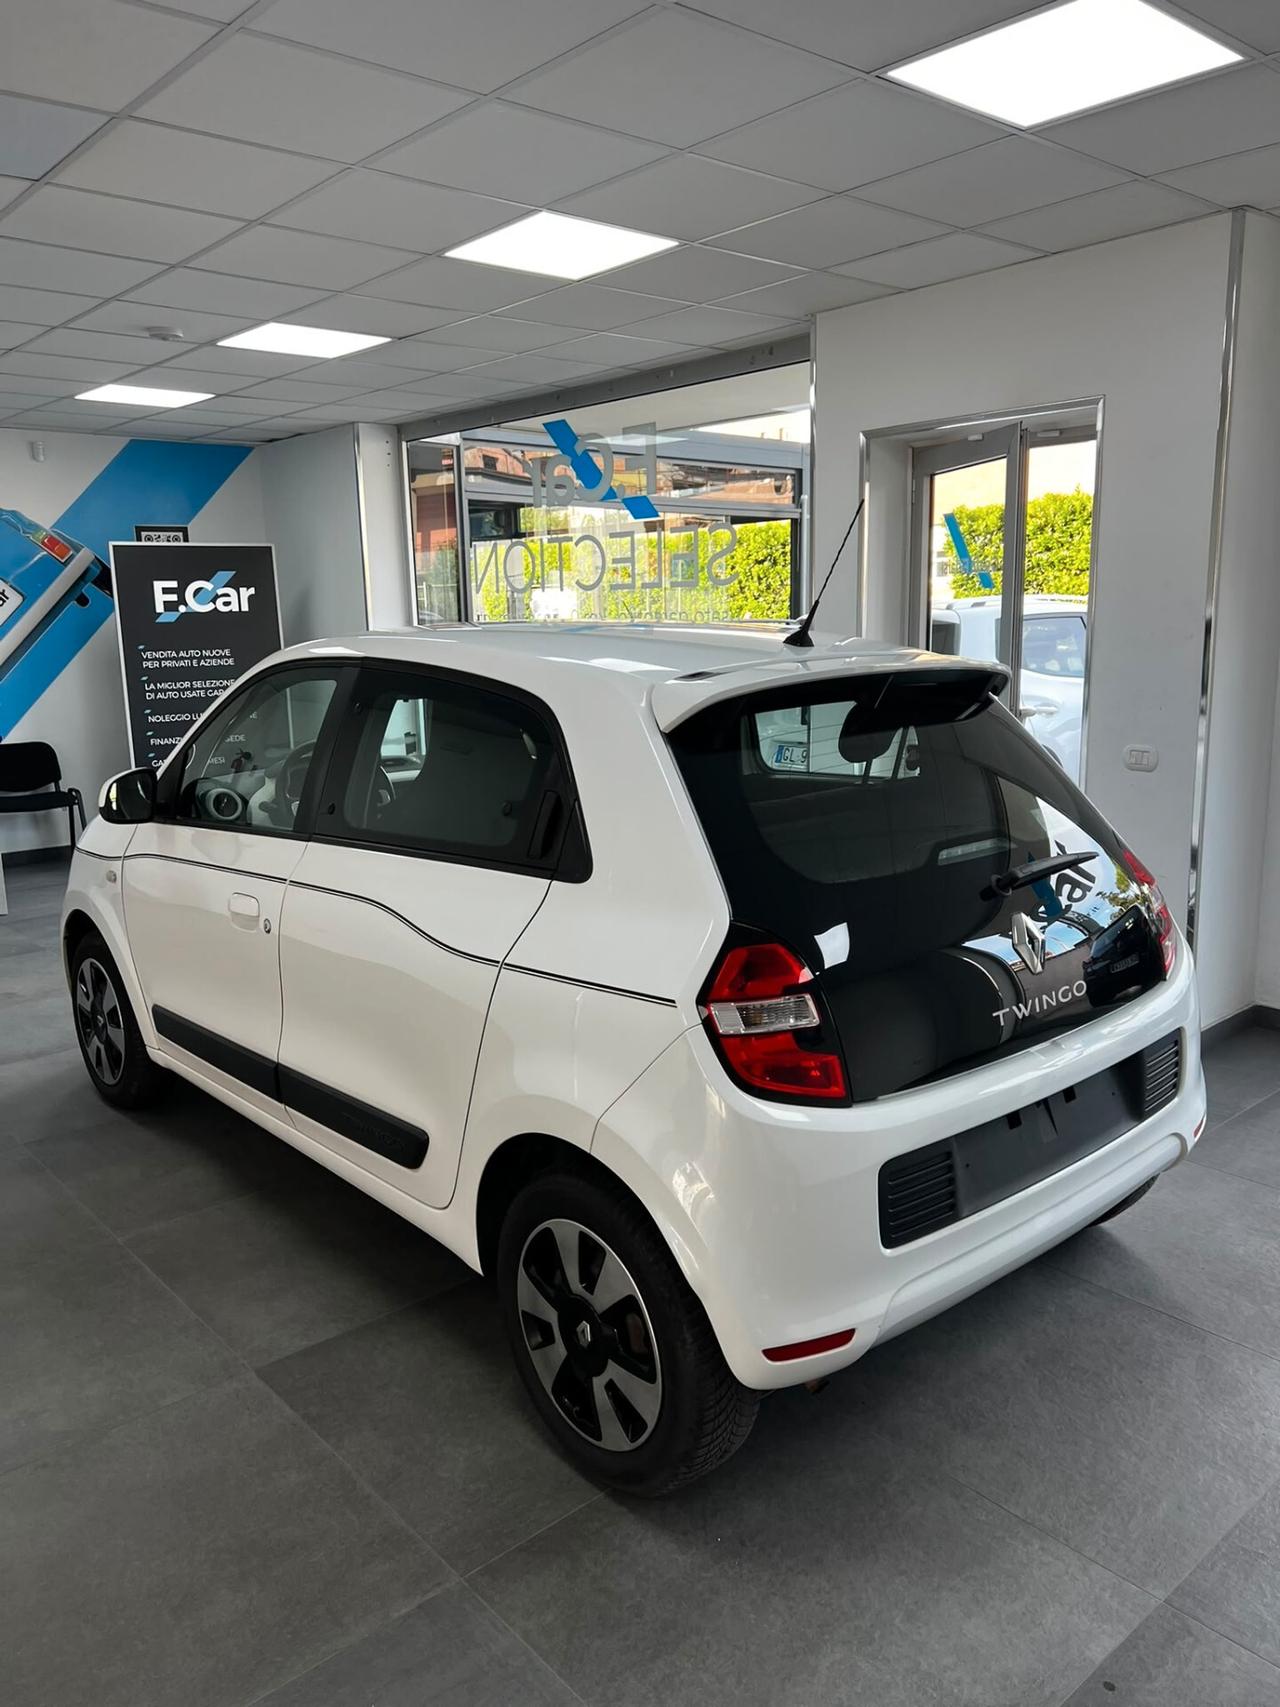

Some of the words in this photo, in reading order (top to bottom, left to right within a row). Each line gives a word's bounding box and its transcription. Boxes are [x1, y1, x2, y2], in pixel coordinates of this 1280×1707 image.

[152, 579, 256, 614] F.Car
[141, 651, 177, 659] VENDITA
[178, 650, 201, 658] AUTO
[202, 648, 231, 657] NUOVE
[142, 660, 160, 669] PER
[161, 659, 191, 668] PRIVATI
[192, 659, 198, 667] E
[199, 657, 235, 667] AZIENDE
[144, 683, 156, 691] LA
[157, 681, 191, 690] MIGLIOR
[145, 692, 155, 700] DI
[156, 691, 179, 699] AUTO
[180, 690, 206, 698] USATE
[207, 689, 224, 697] GAR
[148, 713, 191, 723] NOLEGGIO
[992, 980, 1087, 1026] TWINGO
